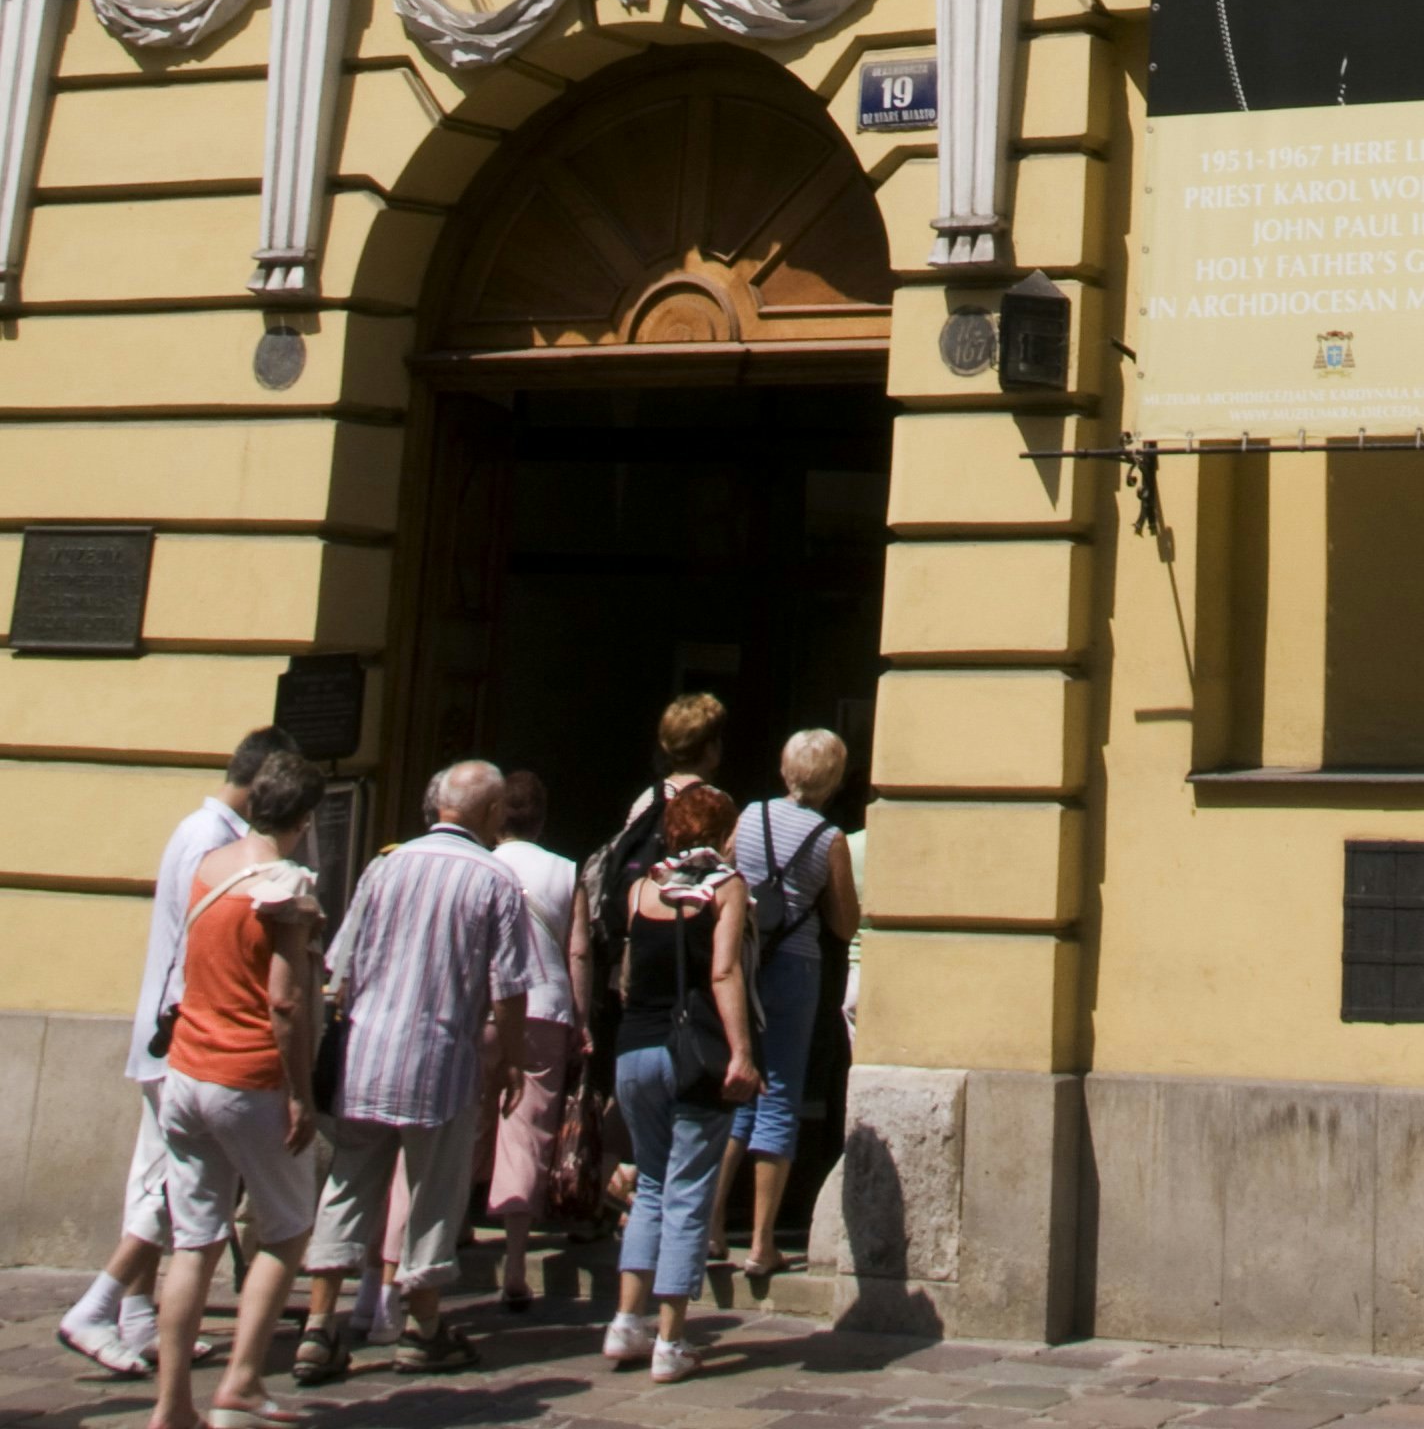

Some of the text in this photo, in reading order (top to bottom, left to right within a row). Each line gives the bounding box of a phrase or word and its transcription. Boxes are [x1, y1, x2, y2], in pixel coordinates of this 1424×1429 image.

[881, 76, 914, 109] 19
[1199, 144, 1325, 175] 1951-1967
[1330, 139, 1399, 168] HERE
[1183, 182, 1266, 211] PRIEST
[1273, 179, 1362, 207] KAROL
[1251, 217, 1326, 248] JOHN
[1333, 213, 1403, 240] PAUL
[1194, 254, 1269, 284] HOLY
[1275, 249, 1399, 279] FATHER'S
[1148, 296, 1178, 321] IN
[1183, 287, 1399, 320] ARCHDIOCESAN
